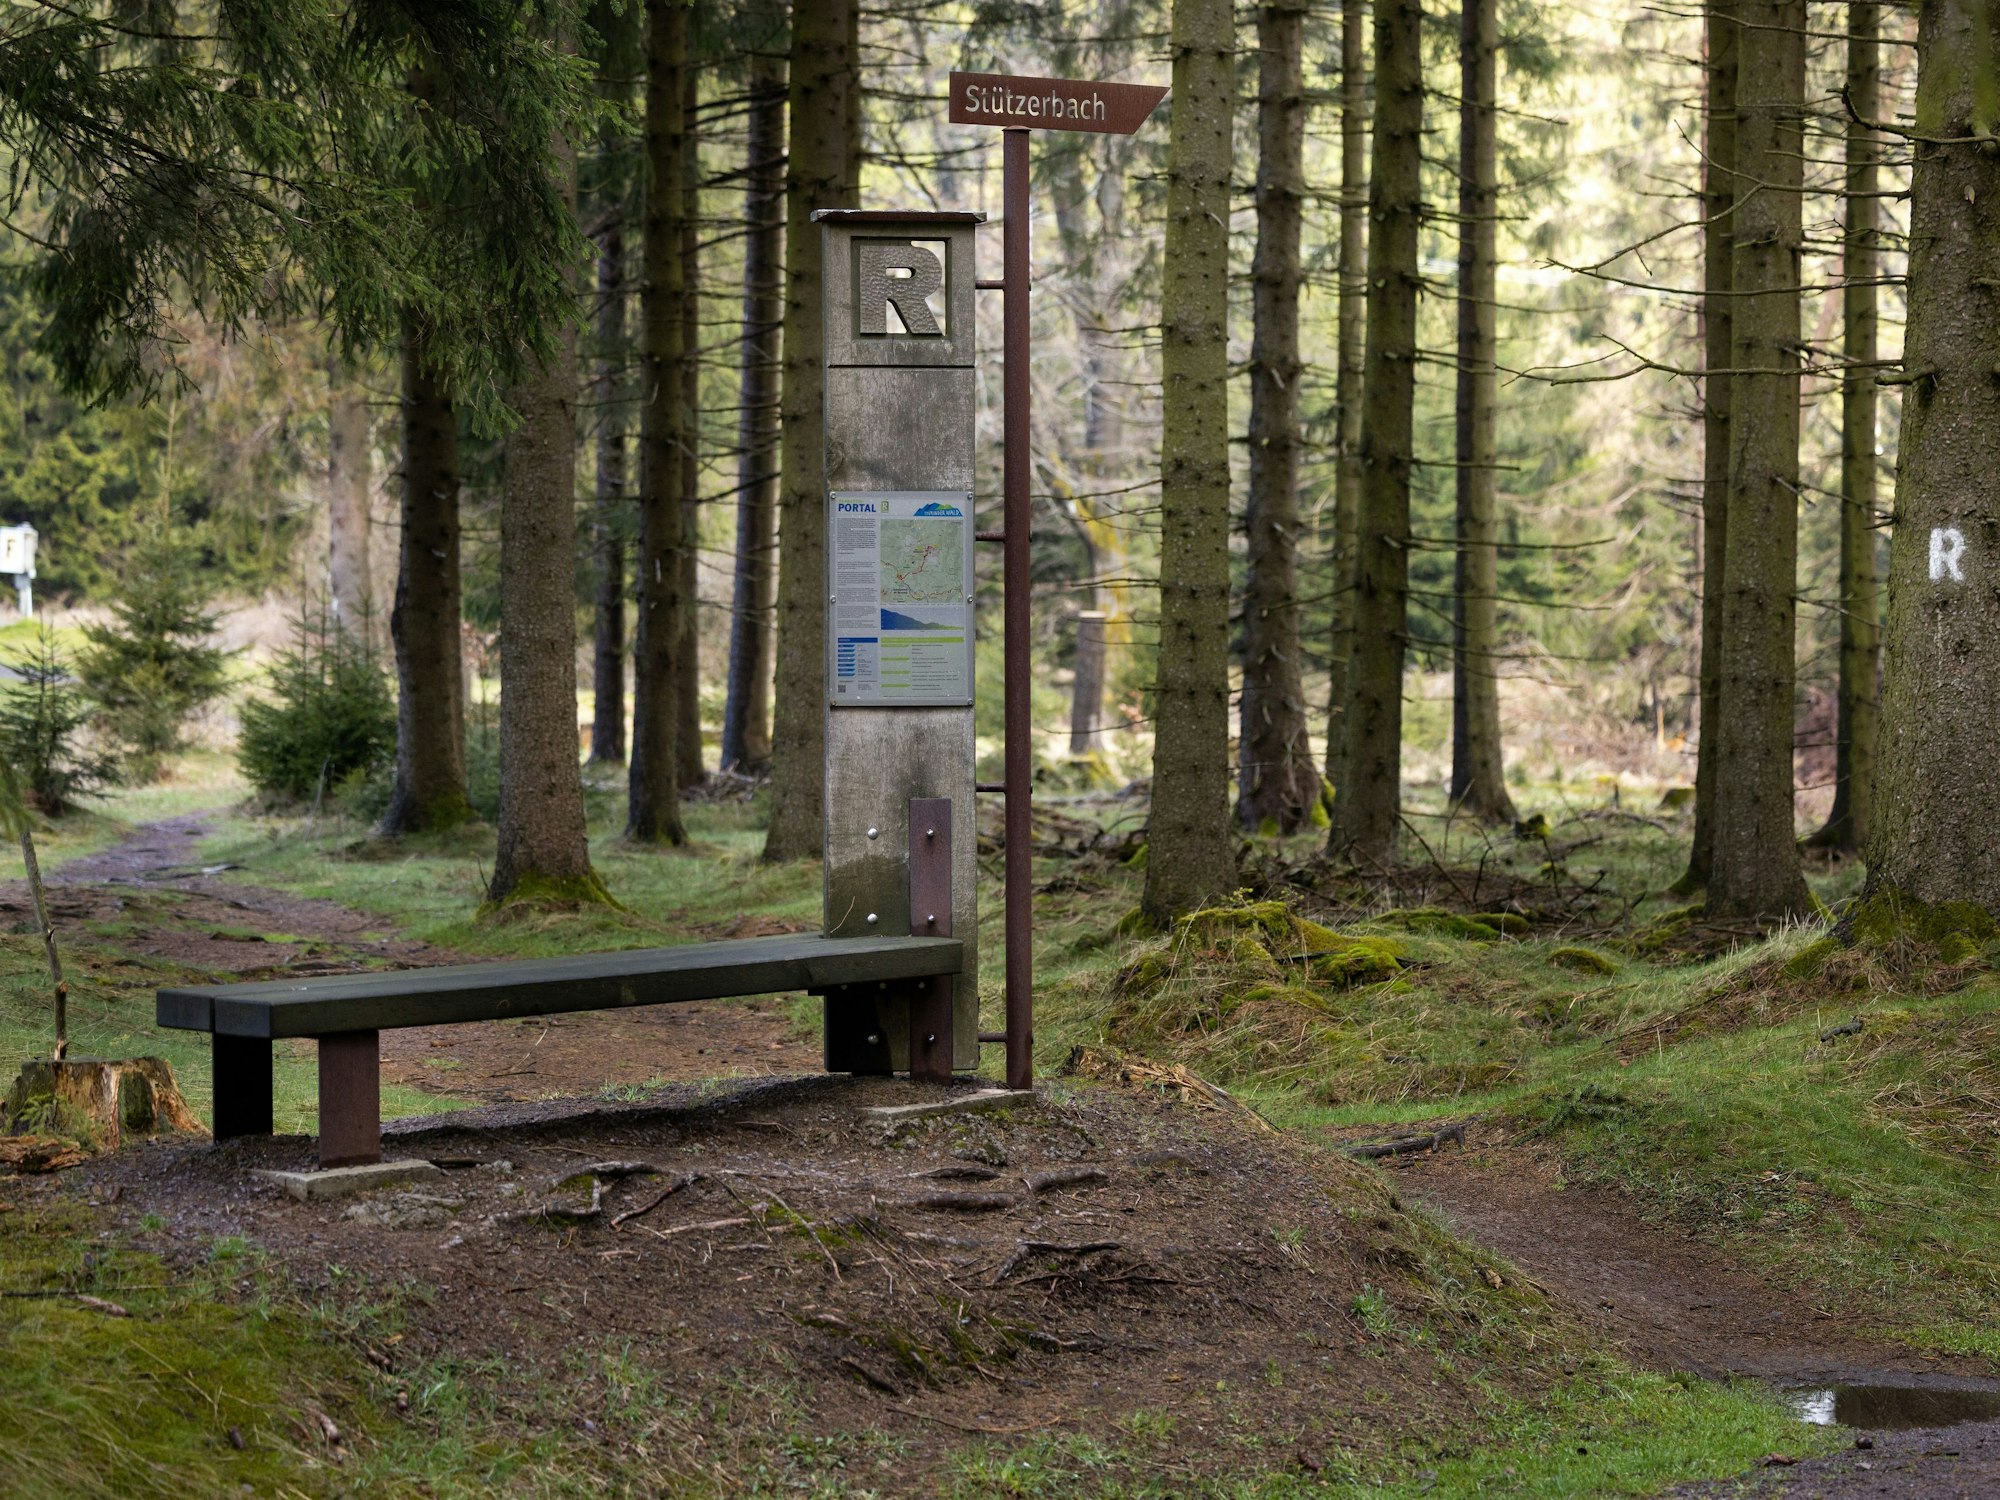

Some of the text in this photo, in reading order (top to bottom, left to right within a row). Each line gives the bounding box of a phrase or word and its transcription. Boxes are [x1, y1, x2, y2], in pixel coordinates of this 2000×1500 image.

[965, 84, 1105, 121] Stützerbach
[860, 245, 943, 335] R
[838, 503, 876, 512] PORTAL
[1929, 527, 1965, 582] R
